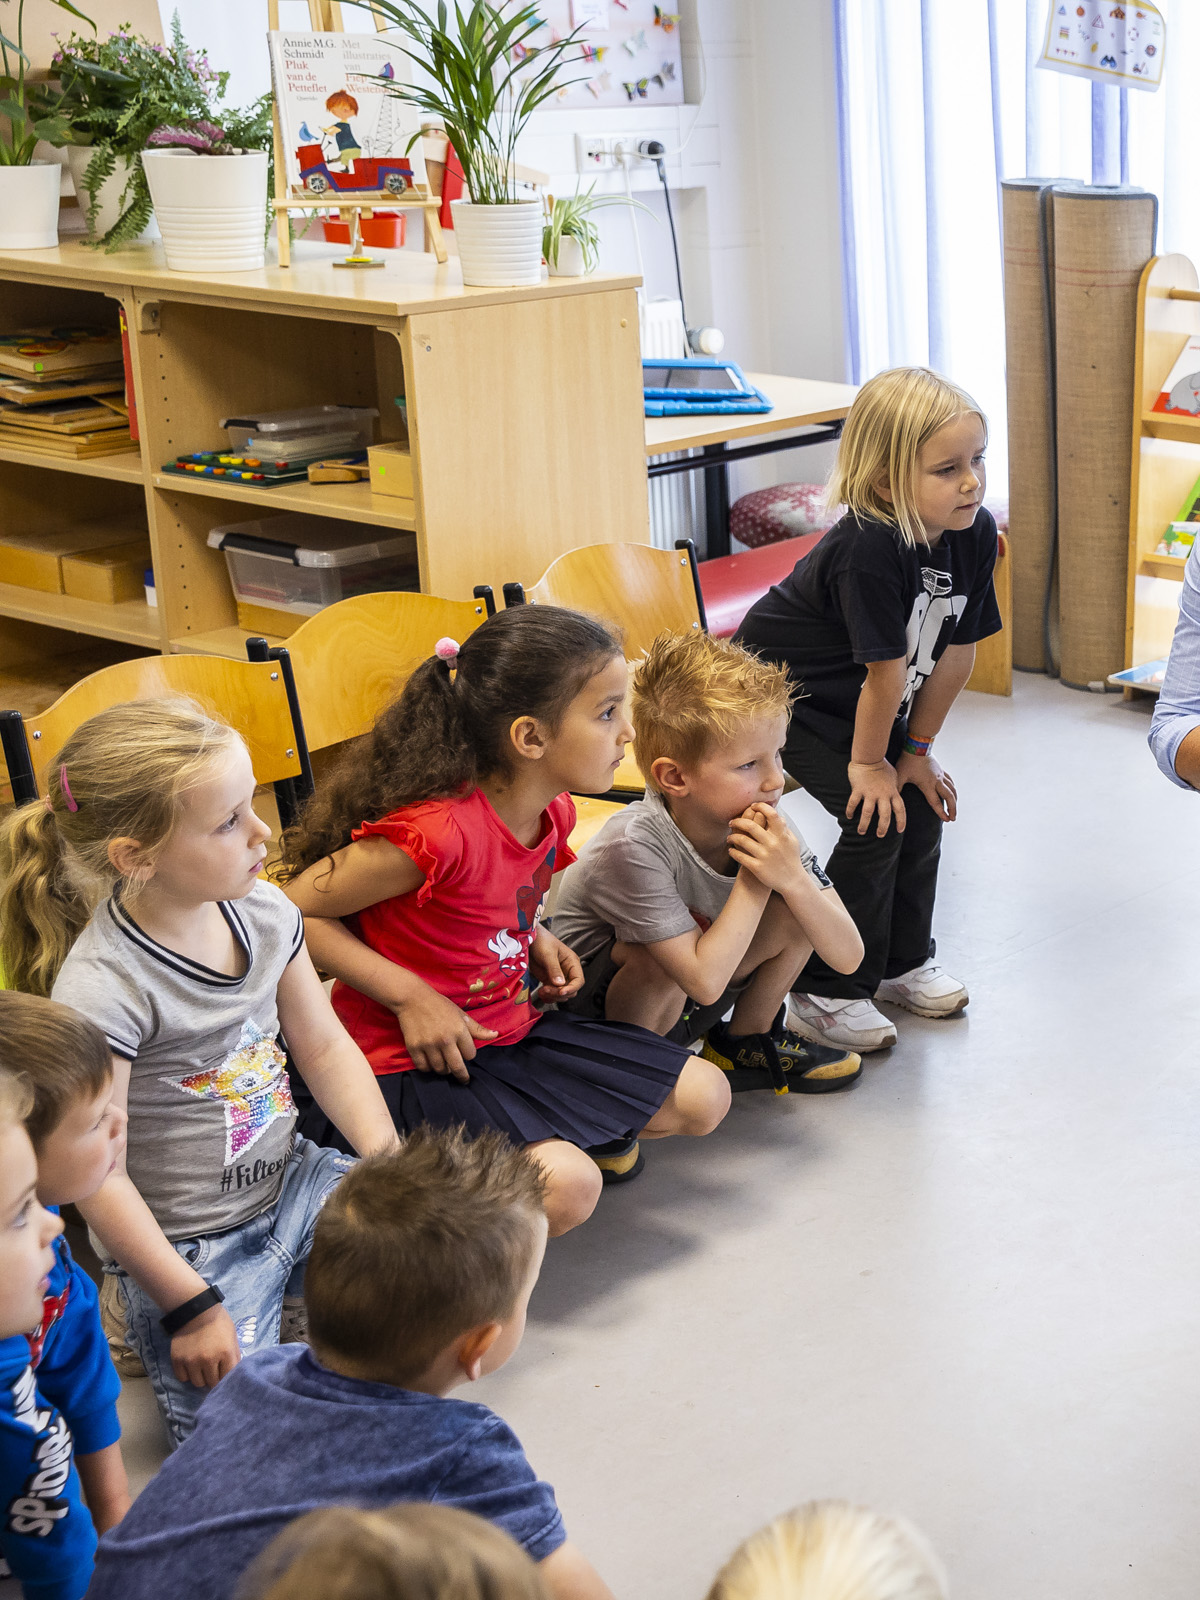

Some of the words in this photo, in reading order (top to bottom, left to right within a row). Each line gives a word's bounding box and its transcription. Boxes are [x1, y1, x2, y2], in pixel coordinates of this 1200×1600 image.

[283, 38, 312, 48] Annie
[313, 39, 337, 48] M.G.
[341, 39, 361, 49] Met
[284, 49, 325, 59] Schmidt
[343, 51, 391, 60] illustraties
[285, 60, 309, 69] Pluk
[305, 72, 317, 81] de
[288, 83, 327, 92] Petteflet
